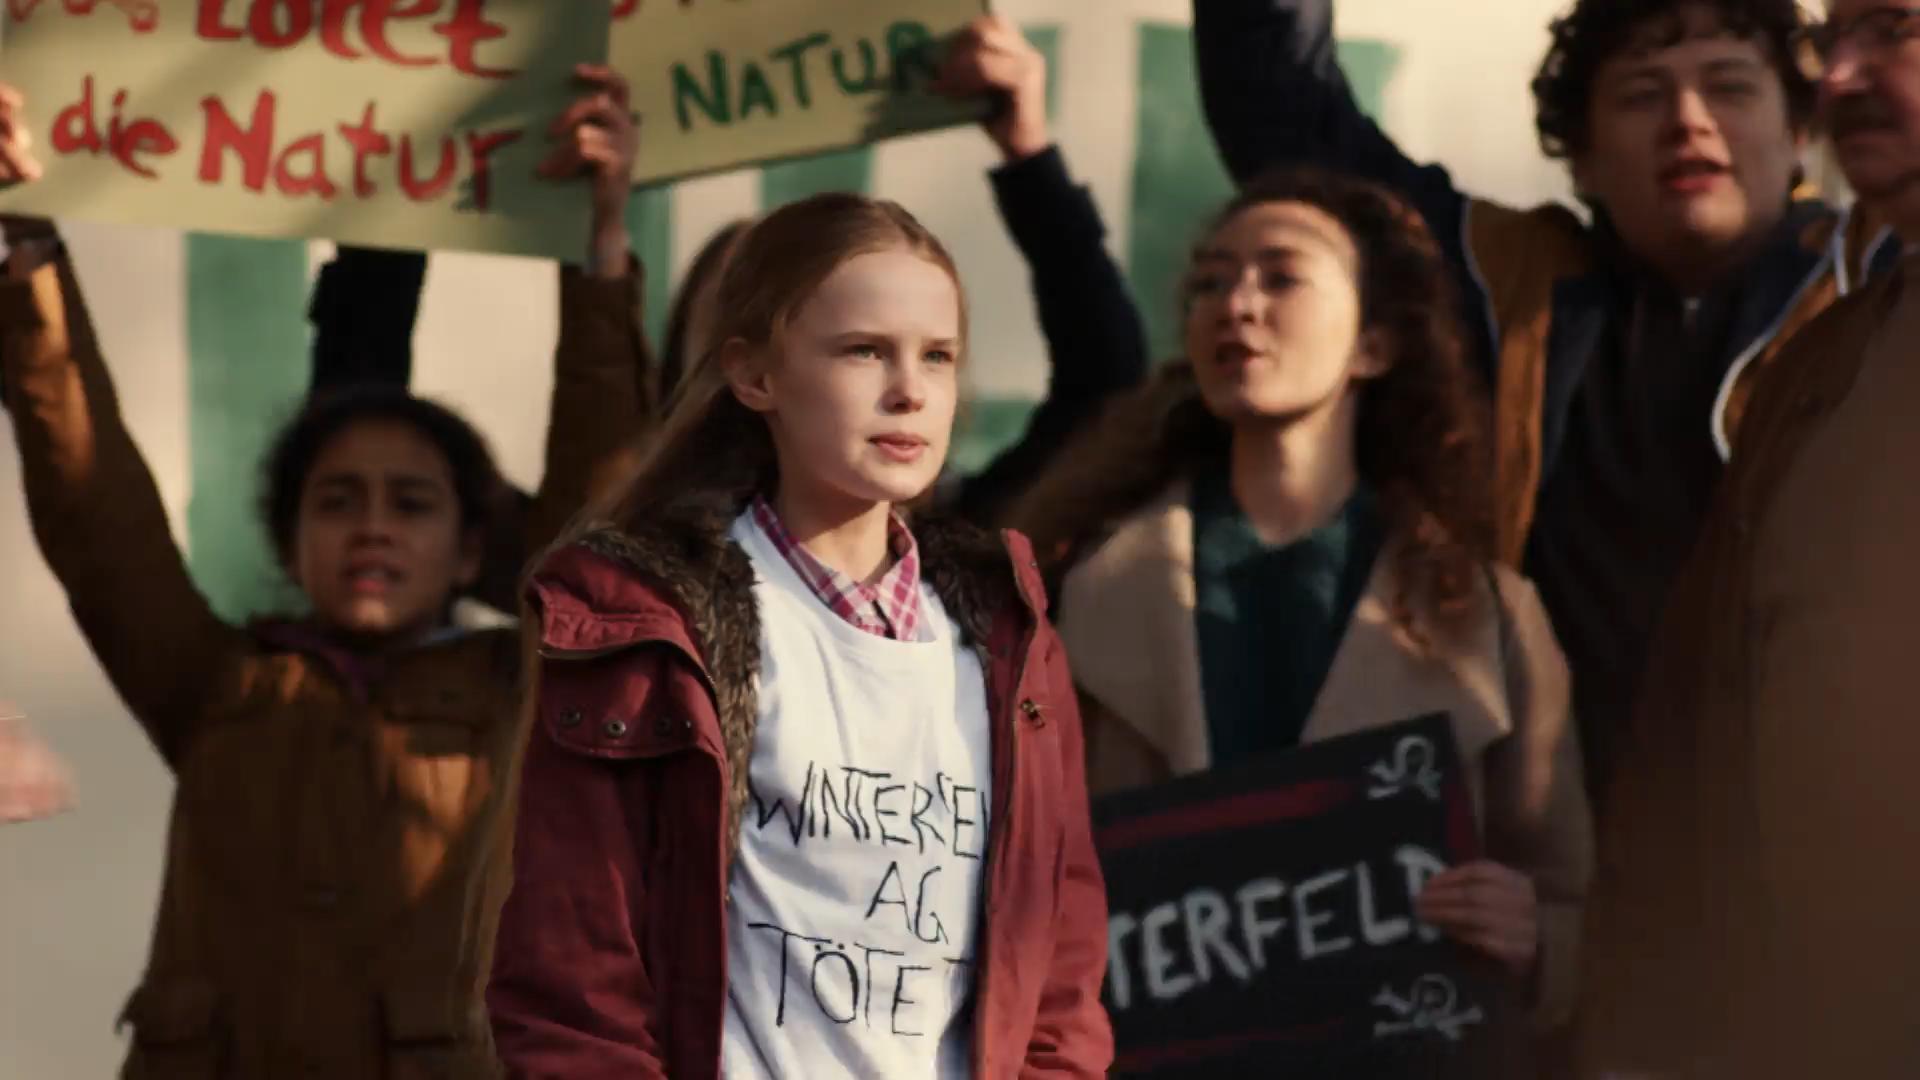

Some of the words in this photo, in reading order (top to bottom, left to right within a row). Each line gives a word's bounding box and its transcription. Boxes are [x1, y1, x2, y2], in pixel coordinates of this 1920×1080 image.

[51, 74, 179, 179] die
[196, 88, 523, 211] Natur
[864, 861, 949, 944] AG
